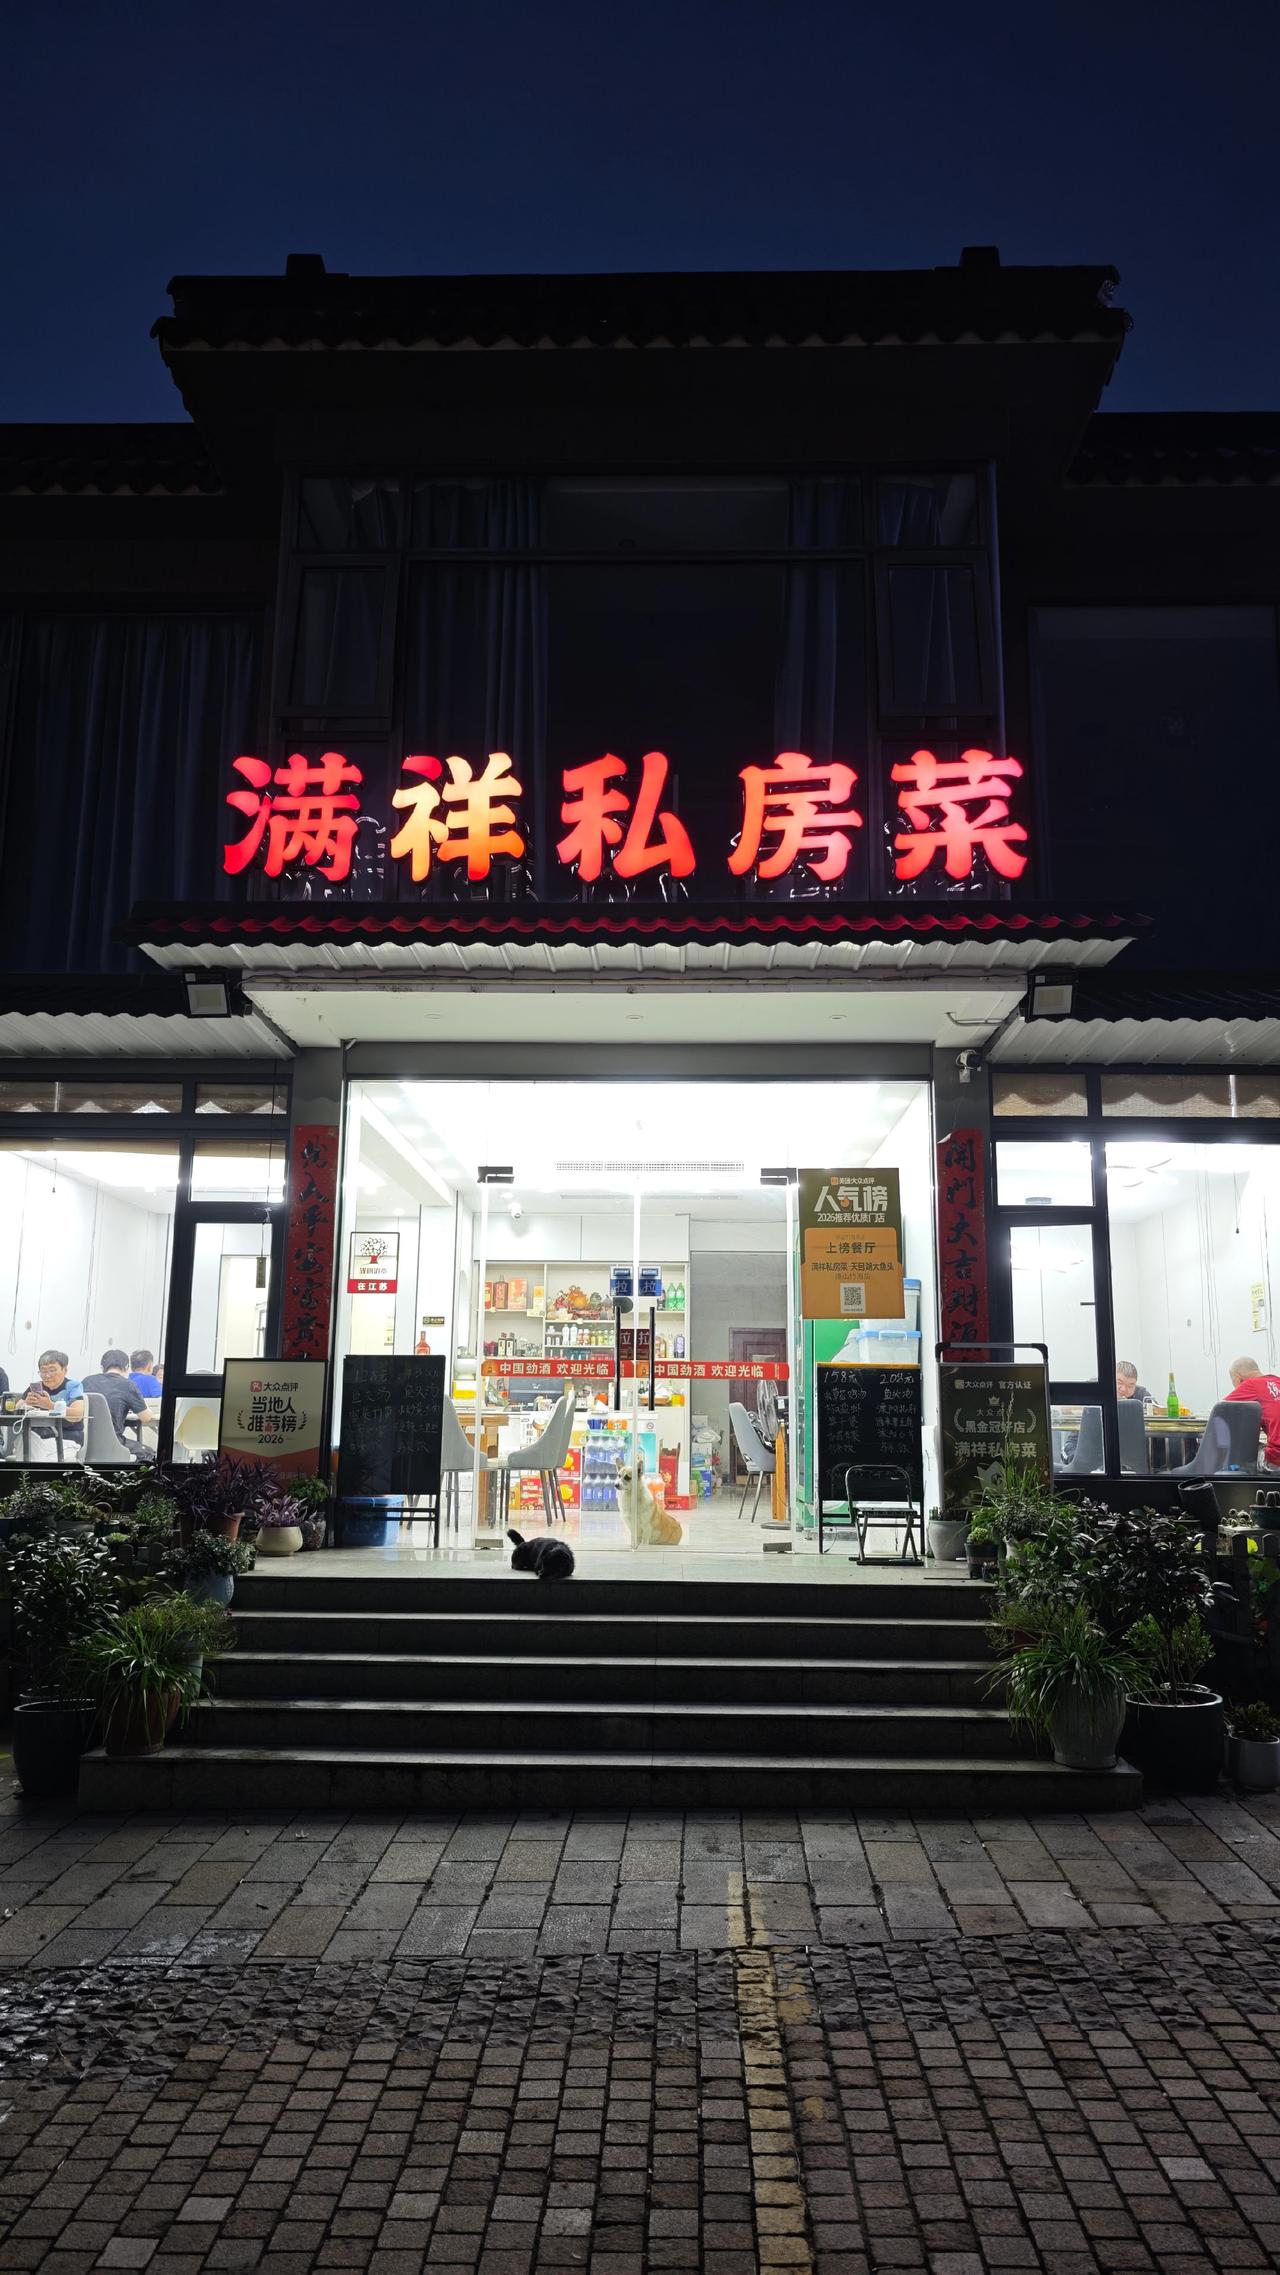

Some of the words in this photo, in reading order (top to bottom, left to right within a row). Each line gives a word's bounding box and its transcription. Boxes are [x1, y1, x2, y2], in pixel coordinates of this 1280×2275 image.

[223, 749, 1029, 884] 满祥私房菜
[813, 1185, 888, 1212] 人气榜
[817, 1212, 886, 1223] 2026推荐优质门店
[826, 1242, 876, 1254] 上榜餐厅
[615, 1280, 628, 1293] 拉
[643, 1280, 657, 1293] 拉
[499, 1362, 551, 1375] 中国劲酒
[556, 1363, 609, 1376] 欢迎光临
[654, 1364, 706, 1376] 中国劲酒
[711, 1365, 764, 1378] 欢迎光临
[263, 1381, 299, 1391] 大众点评
[964, 1381, 993, 1389] 大众点评
[999, 1380, 1032, 1390] 官方认证
[251, 1396, 296, 1414] 当地人
[247, 1415, 297, 1432] 推荐榜
[965, 1420, 1026, 1434] 黑金冠好店
[257, 1434, 284, 1444] 2026
